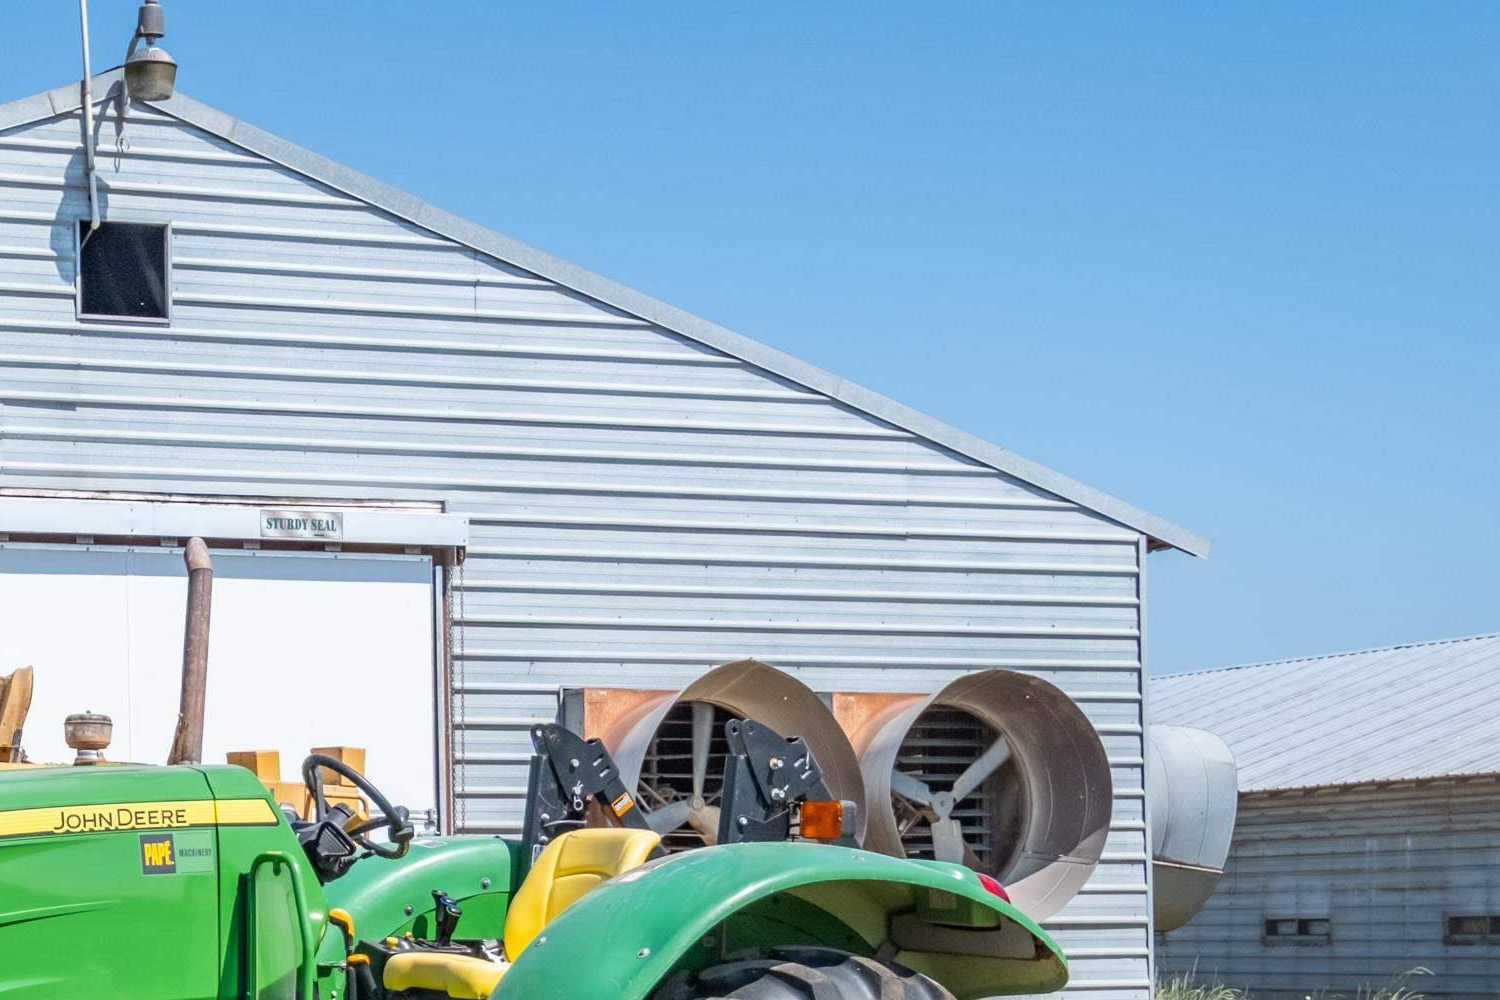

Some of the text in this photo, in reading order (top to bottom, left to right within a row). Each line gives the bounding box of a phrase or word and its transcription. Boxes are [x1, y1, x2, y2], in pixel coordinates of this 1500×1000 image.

[266, 517, 337, 532] STURDY SEAL
[54, 808, 187, 830] JOHN DEERE
[179, 847, 212, 857] MACHINERY
